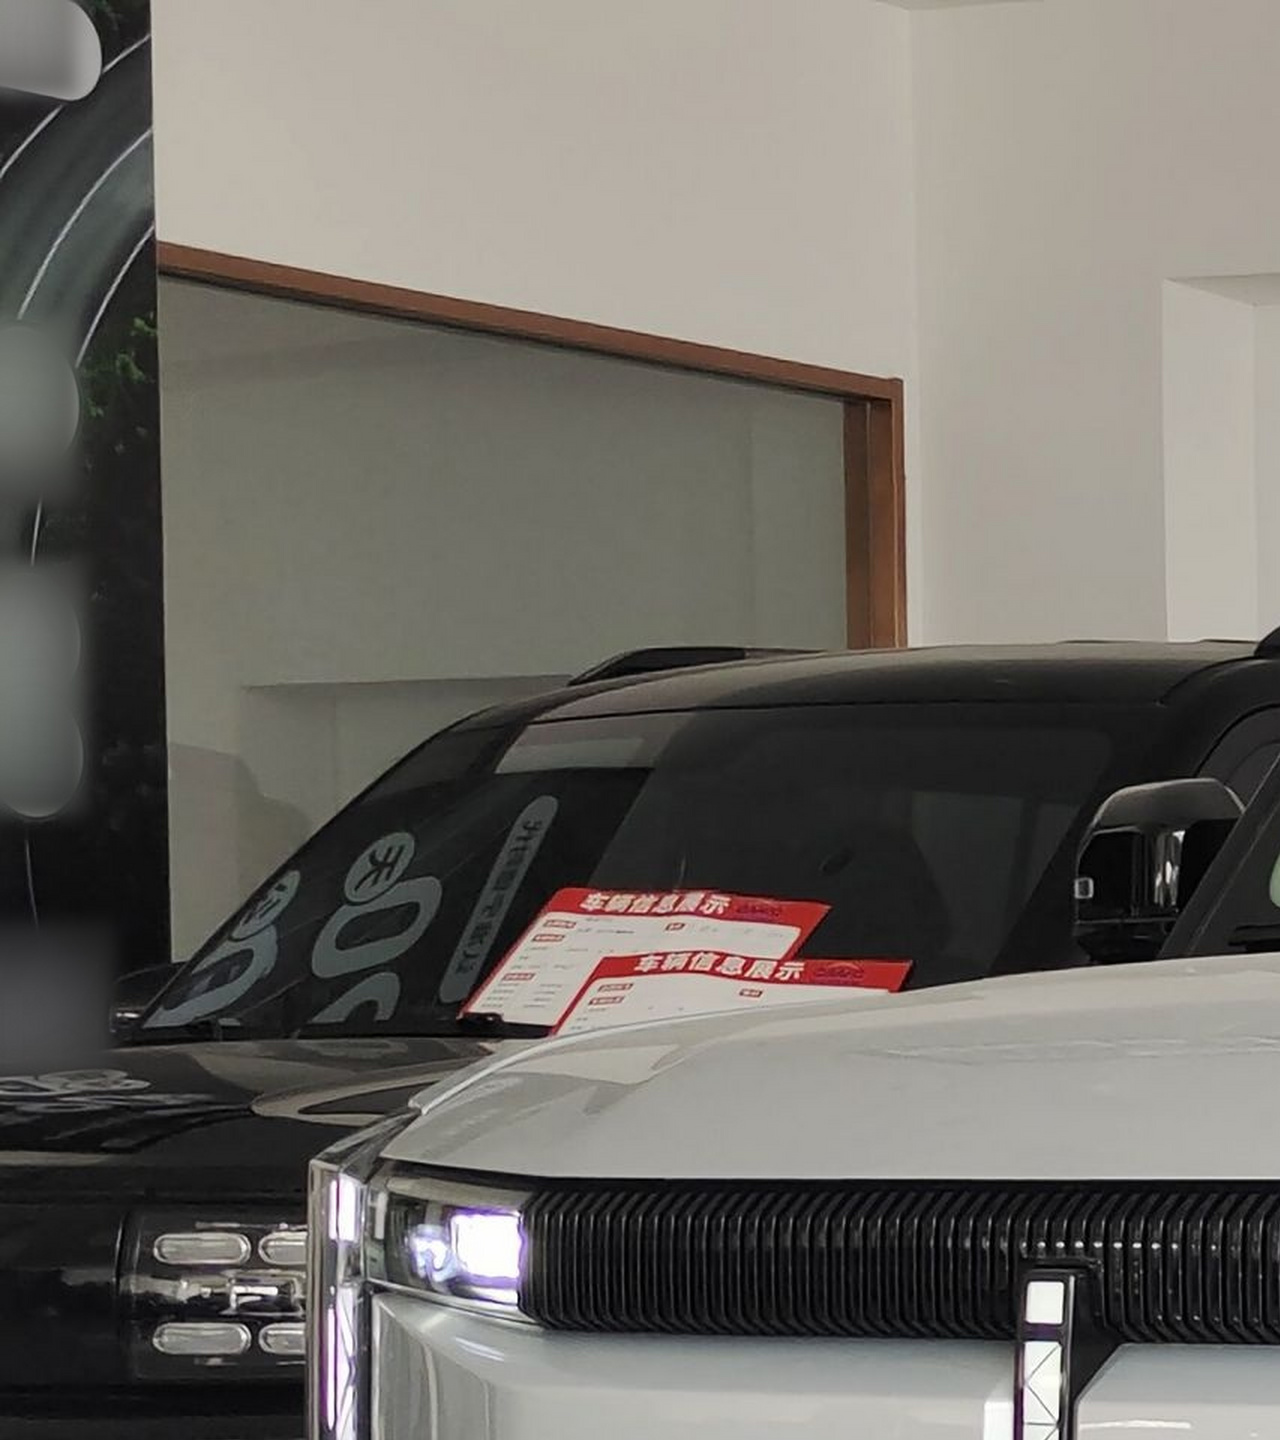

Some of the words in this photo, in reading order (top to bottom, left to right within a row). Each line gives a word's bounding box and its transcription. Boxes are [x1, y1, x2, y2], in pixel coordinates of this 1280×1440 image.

[580, 892, 730, 915] 车辆信息展示
[635, 951, 805, 980] 车辆信息展示
